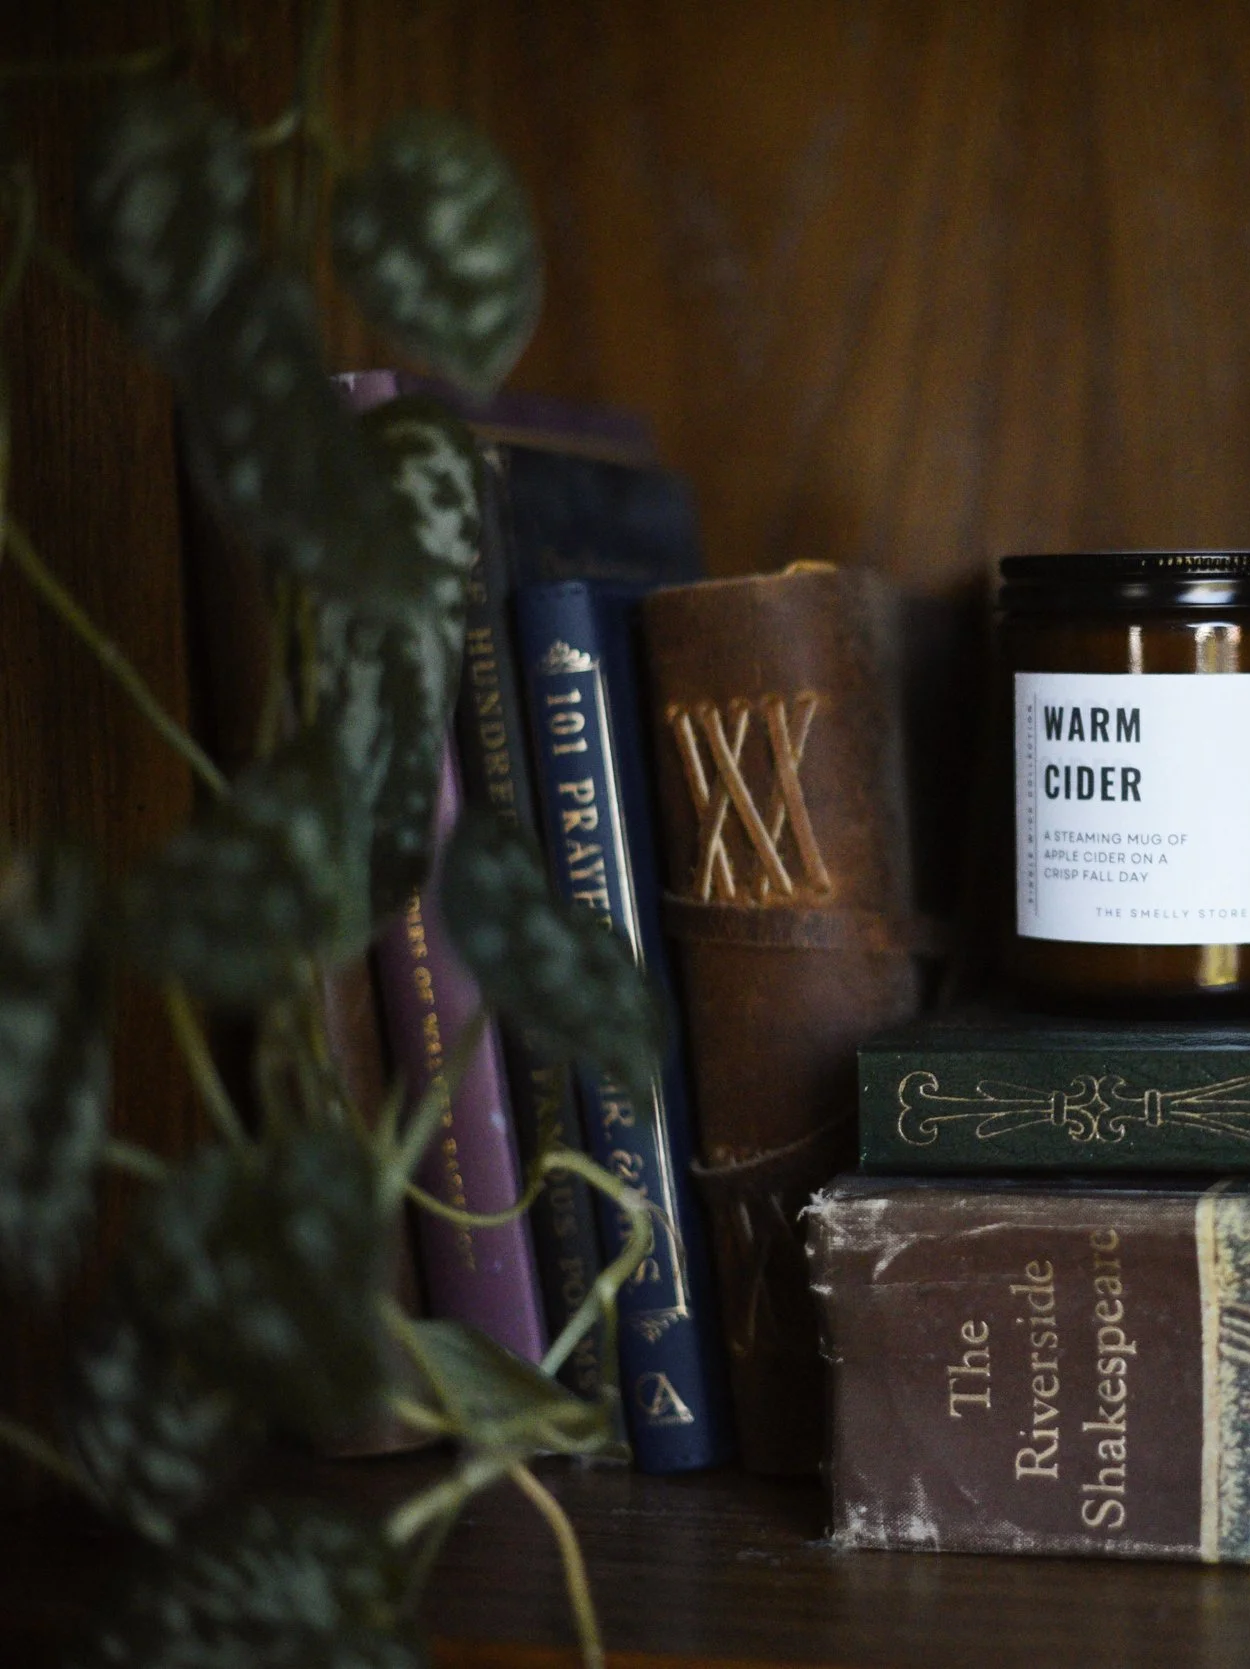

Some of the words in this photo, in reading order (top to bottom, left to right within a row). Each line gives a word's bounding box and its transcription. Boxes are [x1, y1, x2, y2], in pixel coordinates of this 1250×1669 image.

[547, 687, 589, 757] 101
[1043, 705, 1142, 743] WARM
[1043, 764, 1142, 802] CIDER
[557, 776, 613, 931] PRAYE
[1043, 830, 1051, 842] A
[1054, 831, 1122, 845] STEAMING
[1127, 833, 1163, 845] MUG
[1167, 834, 1189, 846] OF
[1043, 849, 1079, 863] APPLE
[1083, 851, 1126, 864] CIDER
[1130, 852, 1154, 865] ON
[1158, 853, 1169, 865] A
[1043, 867, 1079, 881] CRISP
[1082, 870, 1115, 882] FALL
[1118, 871, 1150, 883] DAY
[1095, 906, 1122, 918] THE
[1129, 908, 1190, 919] SMELLY
[1197, 907, 1248, 919] STORE
[560, 1257, 599, 1391] POMS
[946, 1318, 992, 1419] The
[1009, 1258, 1060, 1481] Riverside
[1080, 1226, 1137, 1531] Shakespeare
